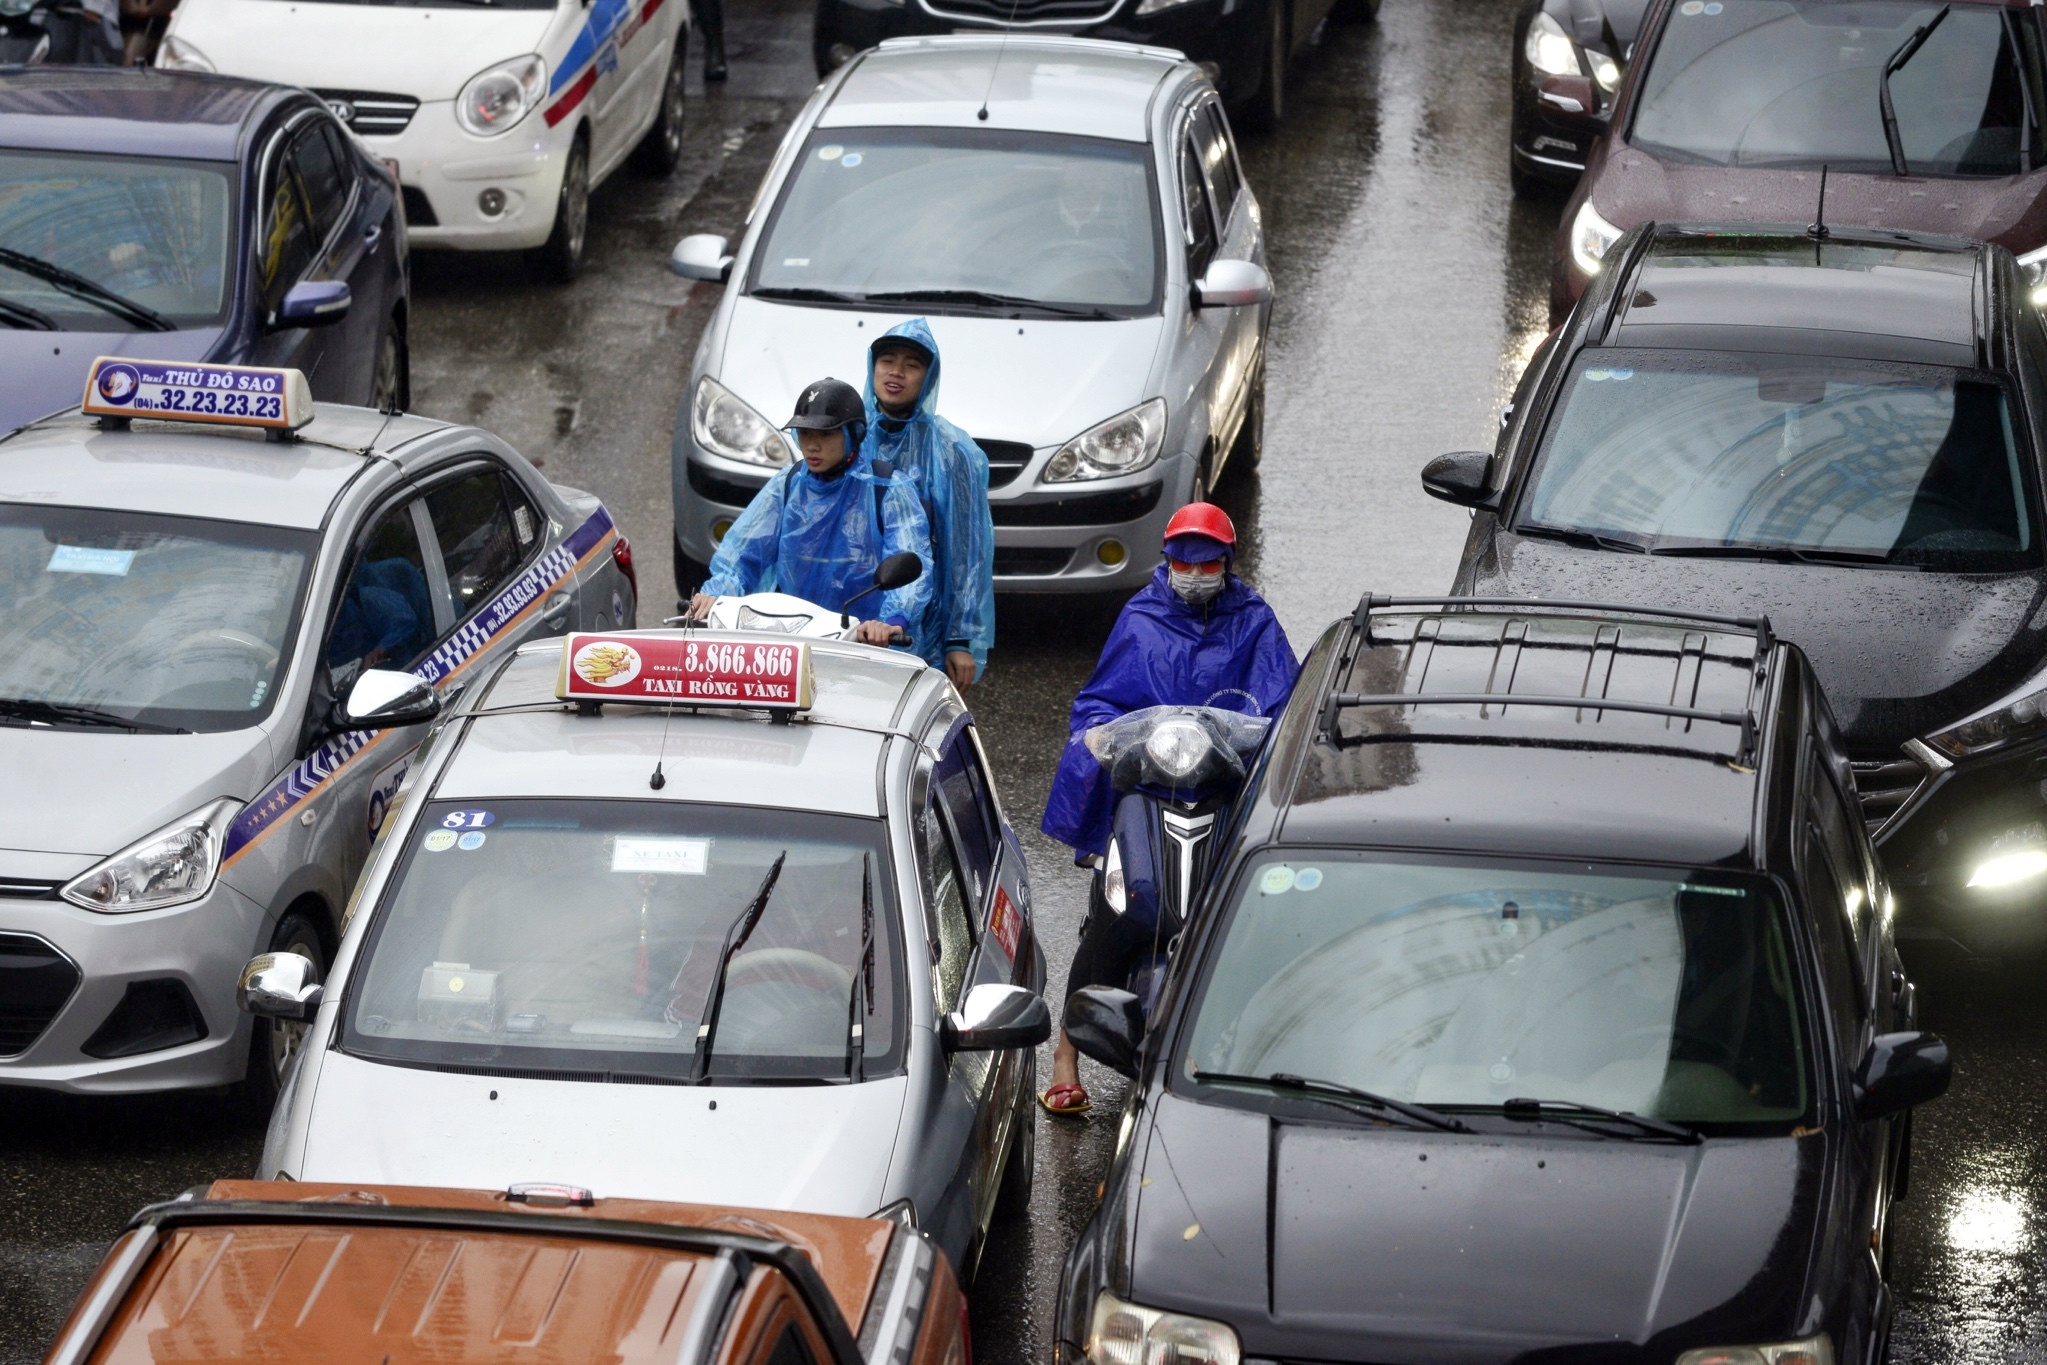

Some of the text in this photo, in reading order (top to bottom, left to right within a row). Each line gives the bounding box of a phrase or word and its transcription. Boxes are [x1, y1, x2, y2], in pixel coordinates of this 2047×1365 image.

[142, 368, 276, 392] Taxi THỦ ĐÔ SAO
[643, 674, 790, 698] TAXI RỒNG VÀNG
[442, 811, 487, 828] 81
[656, 850, 688, 859] TAXI
